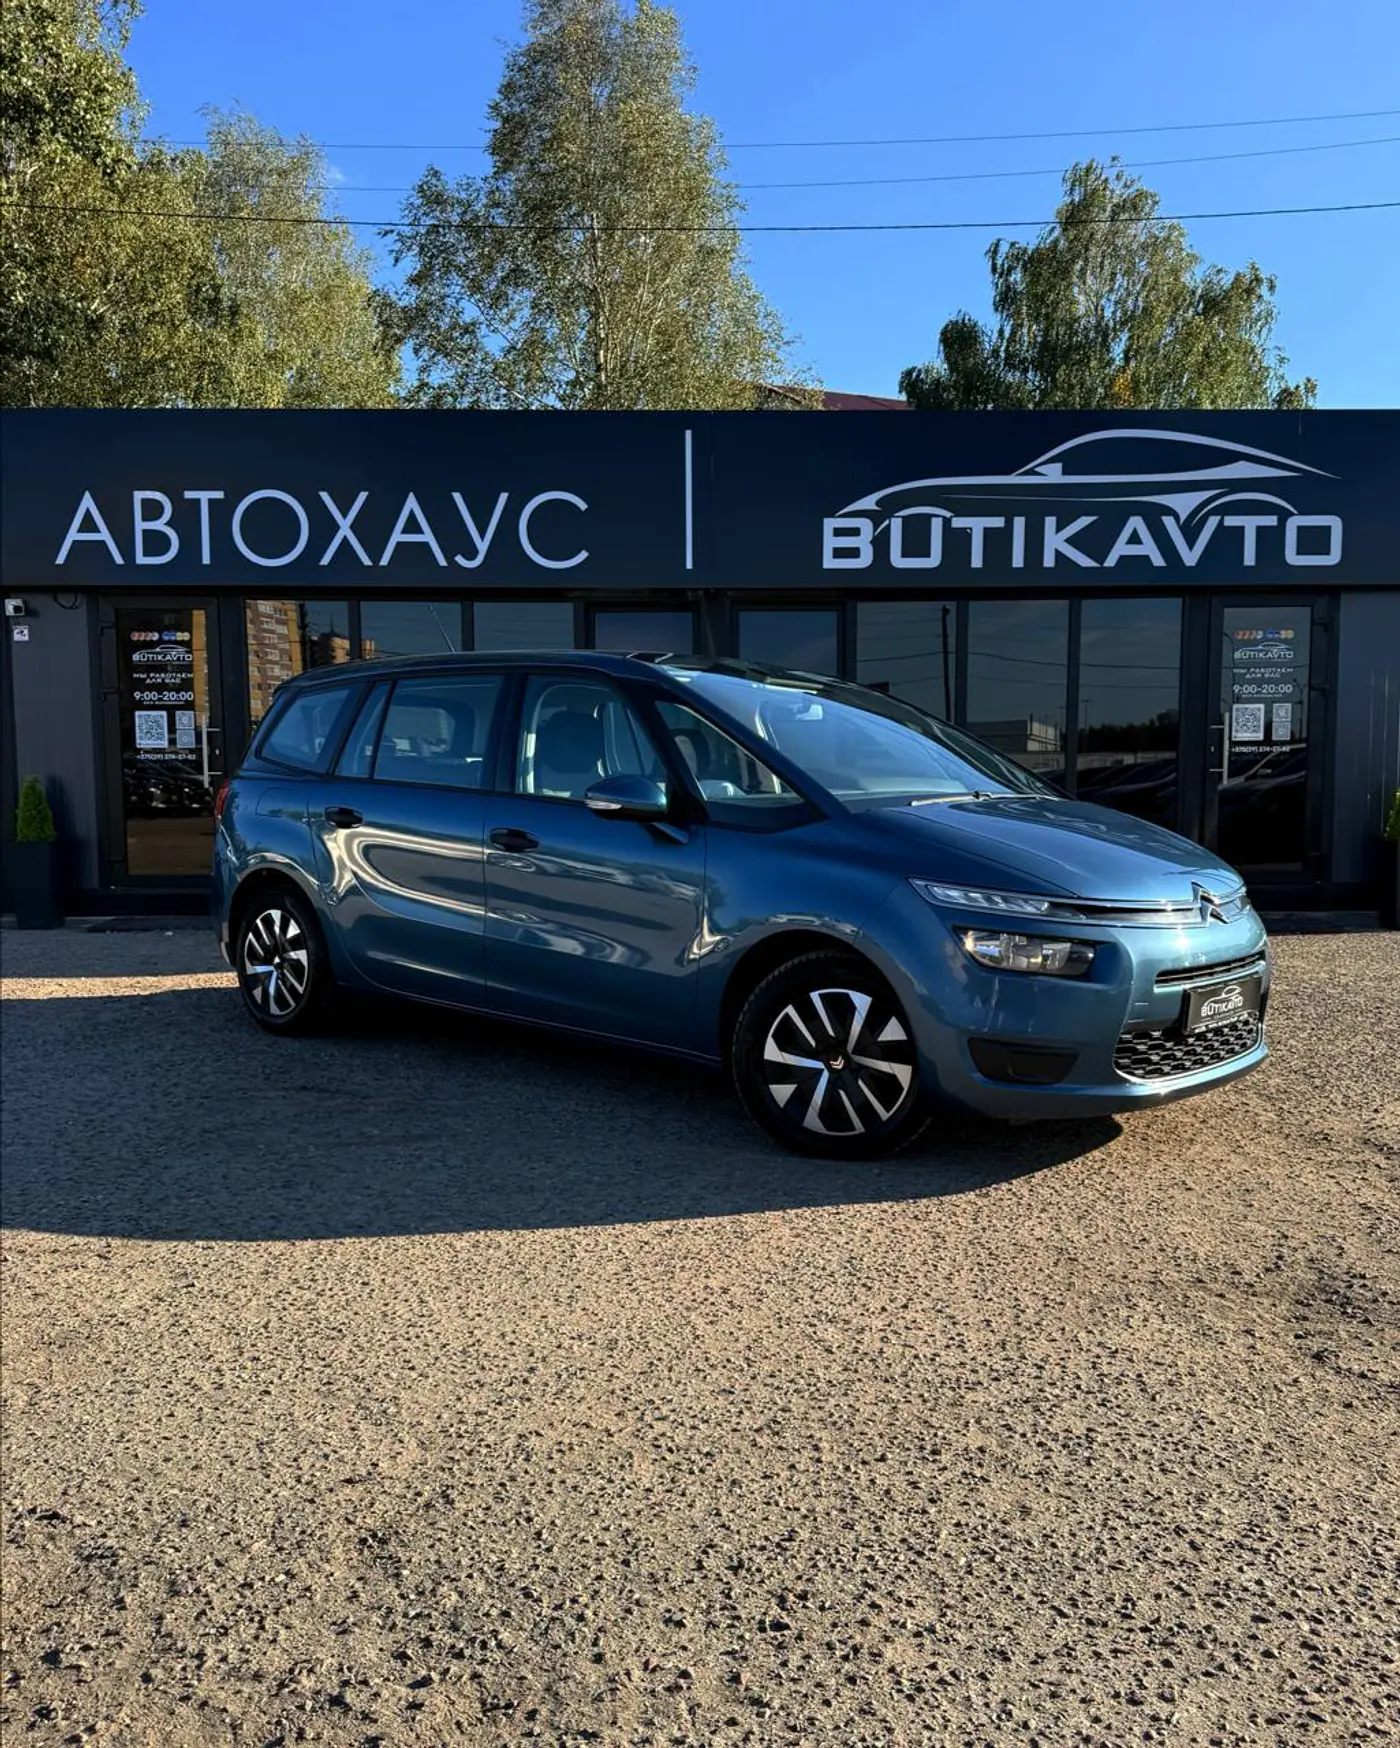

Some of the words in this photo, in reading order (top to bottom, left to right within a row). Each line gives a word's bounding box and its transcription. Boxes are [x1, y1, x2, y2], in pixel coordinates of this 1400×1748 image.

[54, 488, 590, 569] АВТОХАУС
[822, 514, 1343, 569] BUTIKAVTO
[133, 691, 194, 701] 9:00-20:00
[1233, 684, 1293, 694] 9:00-20:00
